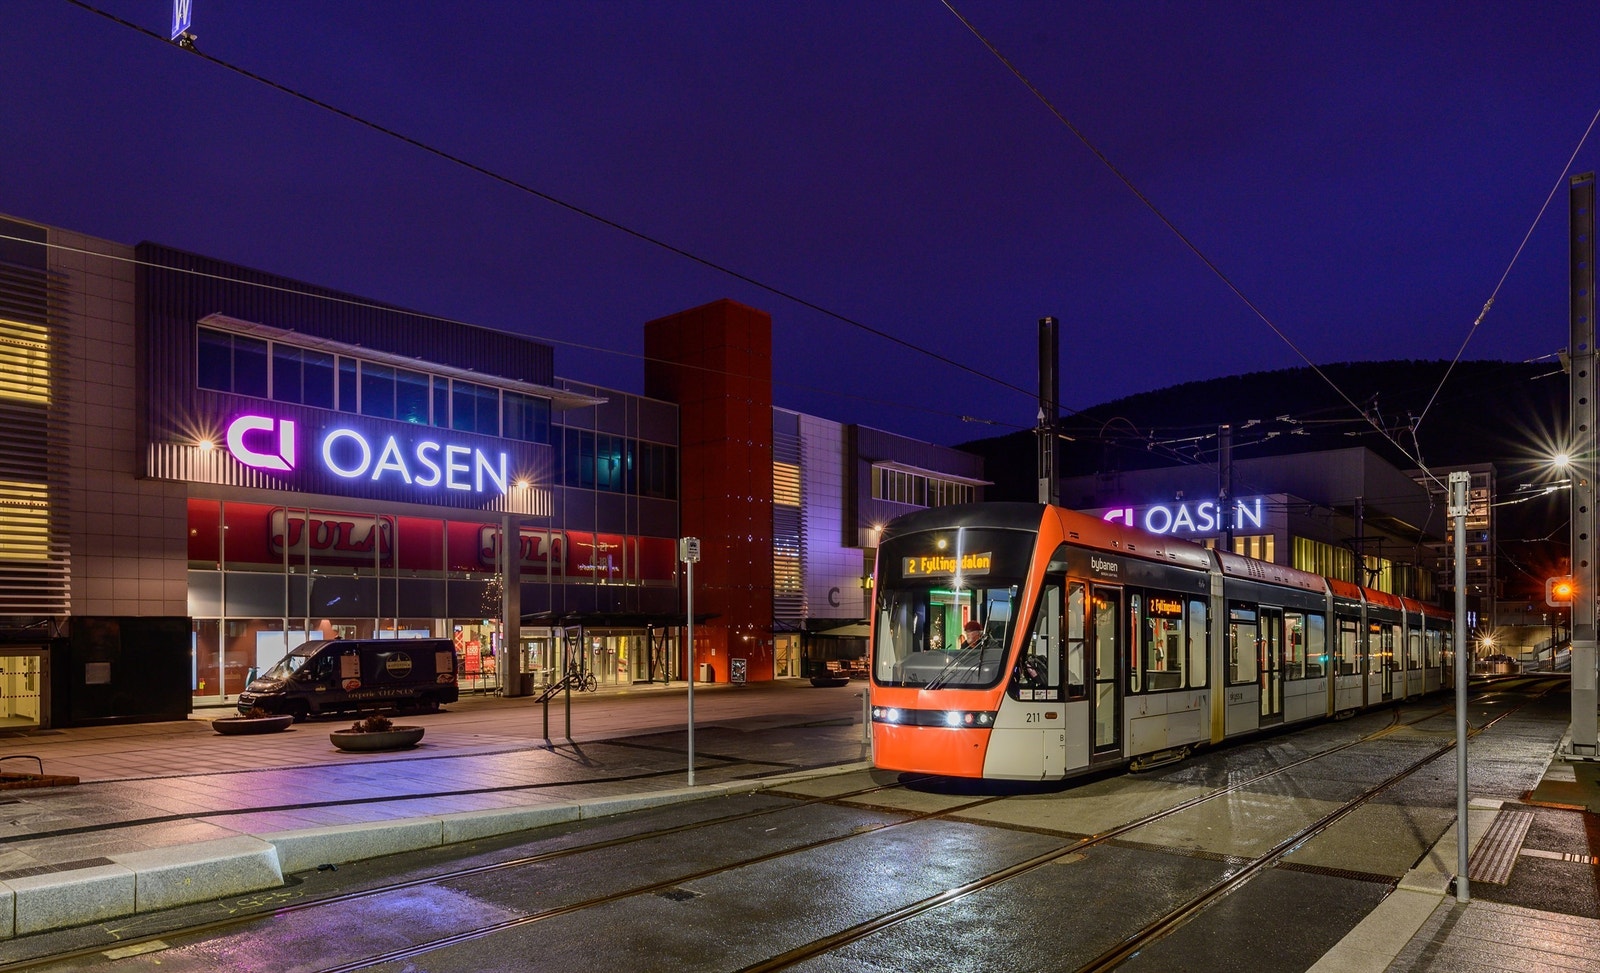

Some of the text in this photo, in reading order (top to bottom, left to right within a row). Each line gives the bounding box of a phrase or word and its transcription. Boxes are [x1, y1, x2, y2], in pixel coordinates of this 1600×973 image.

[322, 428, 507, 495] OASEN
[272, 517, 391, 553] JULA
[909, 559, 916, 574] 2
[1091, 556, 1118, 572] bybanen
[828, 587, 840, 608] C
[1150, 599, 1155, 612] 2
[1026, 712, 1040, 723] 211
